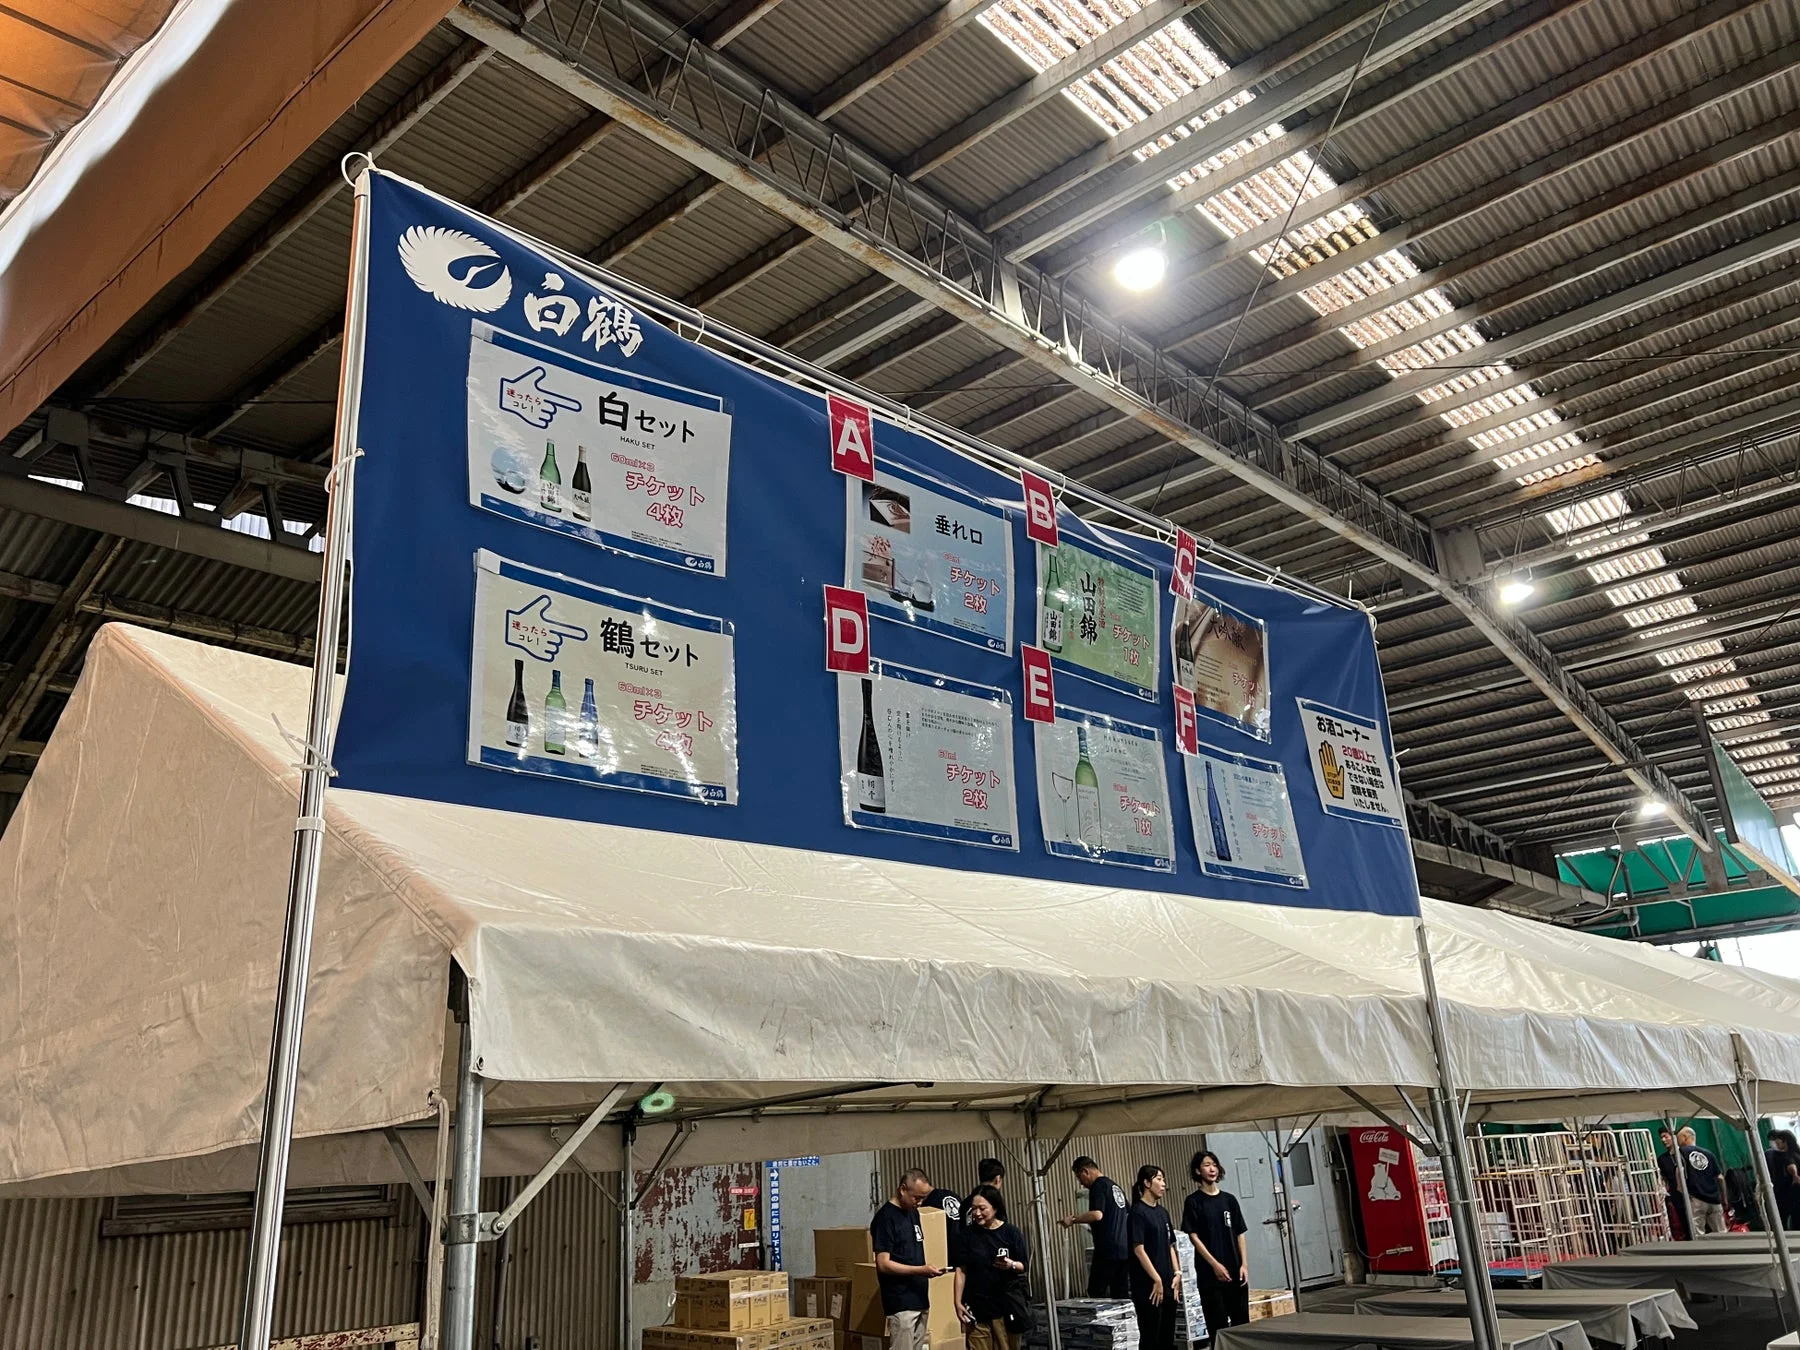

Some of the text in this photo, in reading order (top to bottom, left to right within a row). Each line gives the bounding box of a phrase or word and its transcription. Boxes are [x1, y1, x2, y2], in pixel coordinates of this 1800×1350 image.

[524, 272, 644, 358] 白鶴
[507, 387, 542, 406] 迷ったら
[599, 391, 695, 443] 白セット
[620, 436, 655, 450] HAKU SET
[836, 419, 870, 464] A
[625, 471, 705, 507] チケット
[646, 502, 684, 529] 4枚
[1028, 489, 1053, 530] B
[950, 566, 1001, 597] チケット
[1176, 547, 1194, 589] C
[963, 592, 988, 614] 2枚
[1079, 571, 1098, 646] 山田錦
[512, 619, 548, 638] 迷ったら
[832, 607, 865, 654] D
[1112, 623, 1151, 650] チケット
[600, 617, 699, 668] 鶴セット
[625, 662, 663, 677] TSURU SET
[1123, 646, 1141, 668] 1枚
[1029, 664, 1050, 707] E
[633, 700, 714, 732] チケット
[1180, 702, 1193, 737] F
[1316, 715, 1370, 742] お酒コーナー
[946, 763, 1001, 789] チケット
[962, 788, 988, 811] 2枚
[1120, 795, 1160, 817] チケット
[1133, 817, 1152, 837] 1枚
[1360, 1131, 1389, 1143] Coca-Cola
